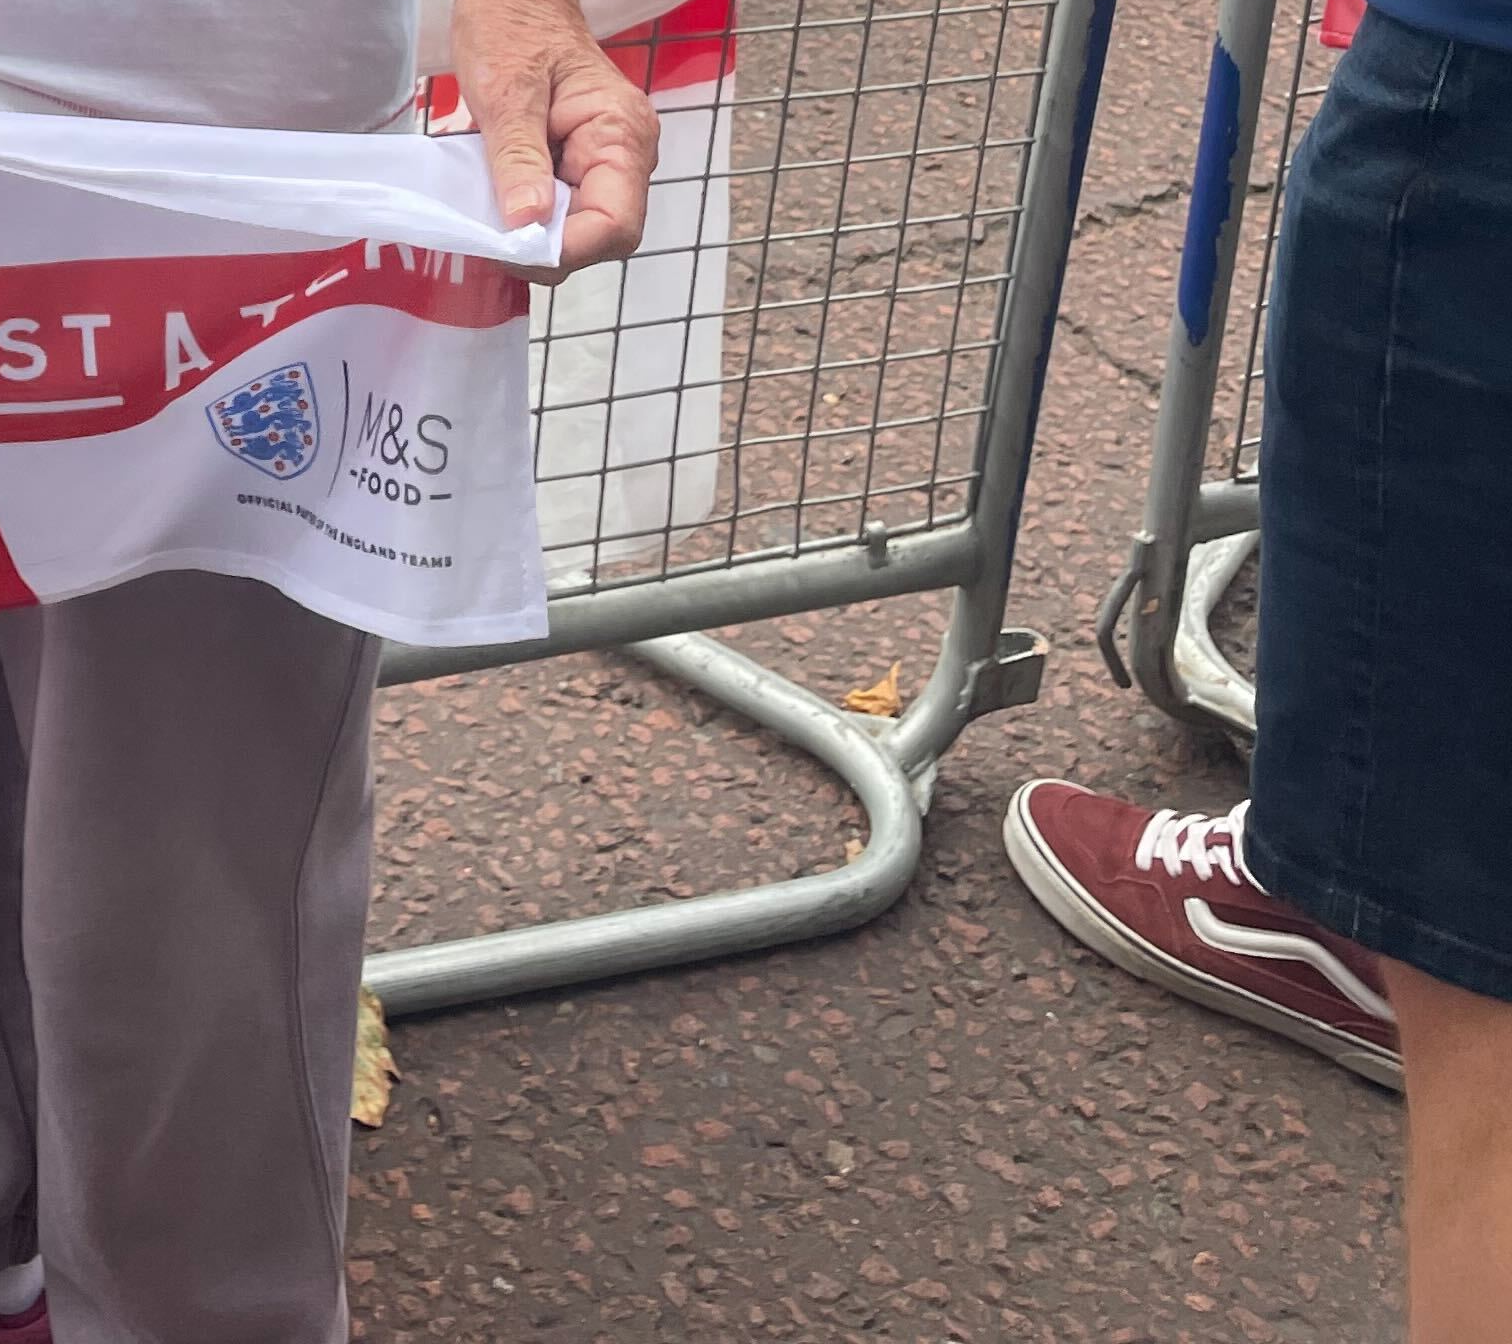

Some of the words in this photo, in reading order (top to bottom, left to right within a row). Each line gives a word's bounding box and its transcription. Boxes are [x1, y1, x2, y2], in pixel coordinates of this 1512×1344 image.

[164, 310, 215, 392] A
[355, 390, 453, 476] M&S
[236, 492, 293, 514] OFFICIAL
[339, 531, 397, 561] ENGLAND
[401, 550, 453, 569] TEAMS
